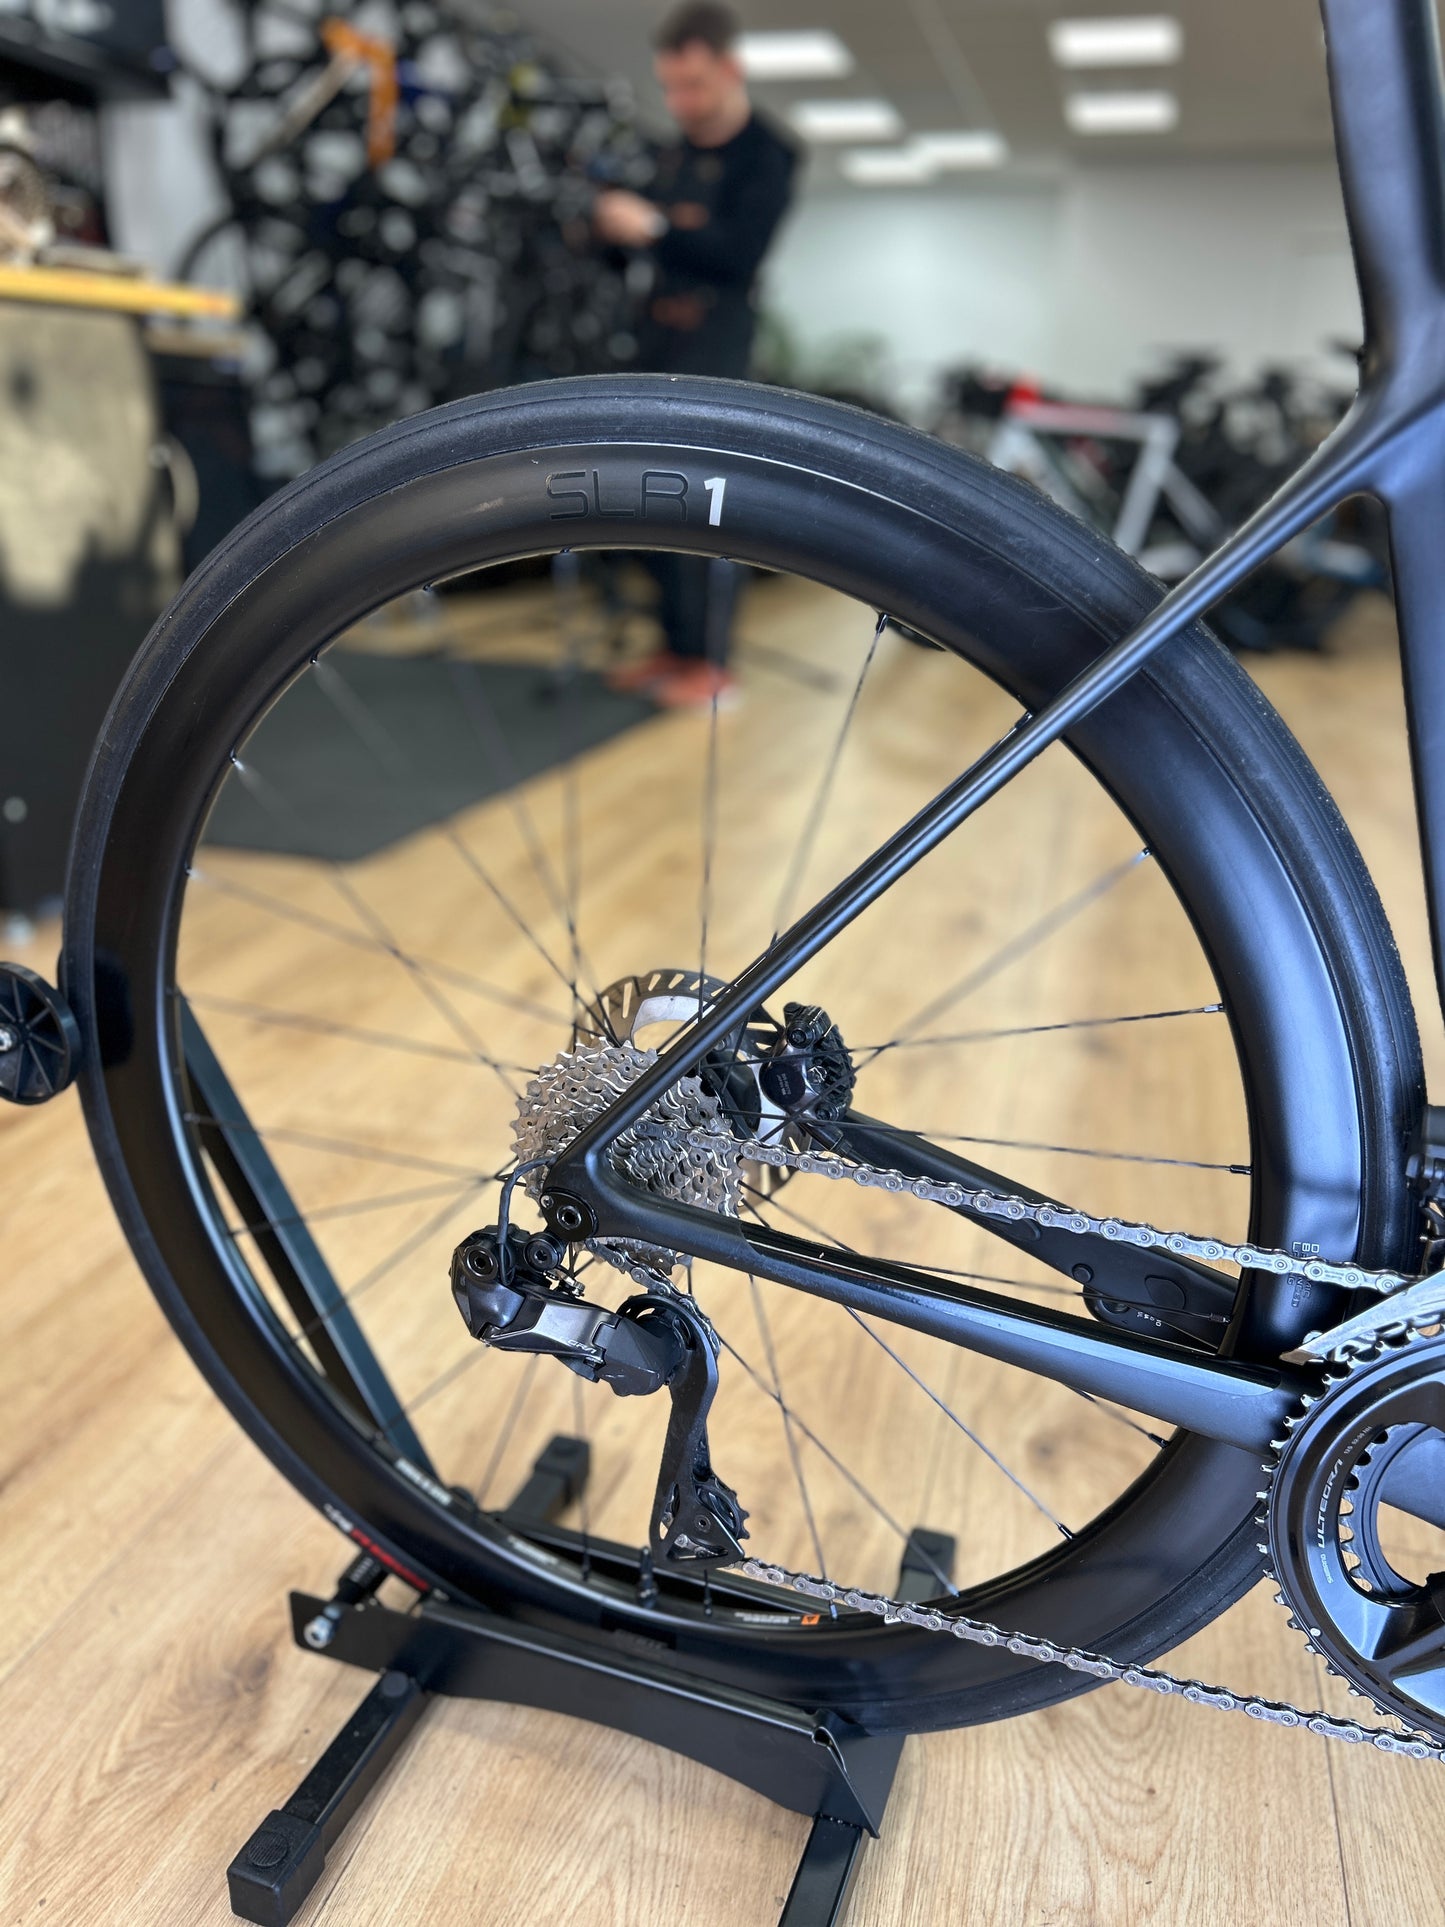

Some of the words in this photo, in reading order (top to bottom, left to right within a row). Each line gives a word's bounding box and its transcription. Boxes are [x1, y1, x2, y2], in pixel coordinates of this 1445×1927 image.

[545, 469, 689, 521] SLR
[704, 476, 727, 527] 1
[1317, 1458, 1344, 1549] ULTEGRA
